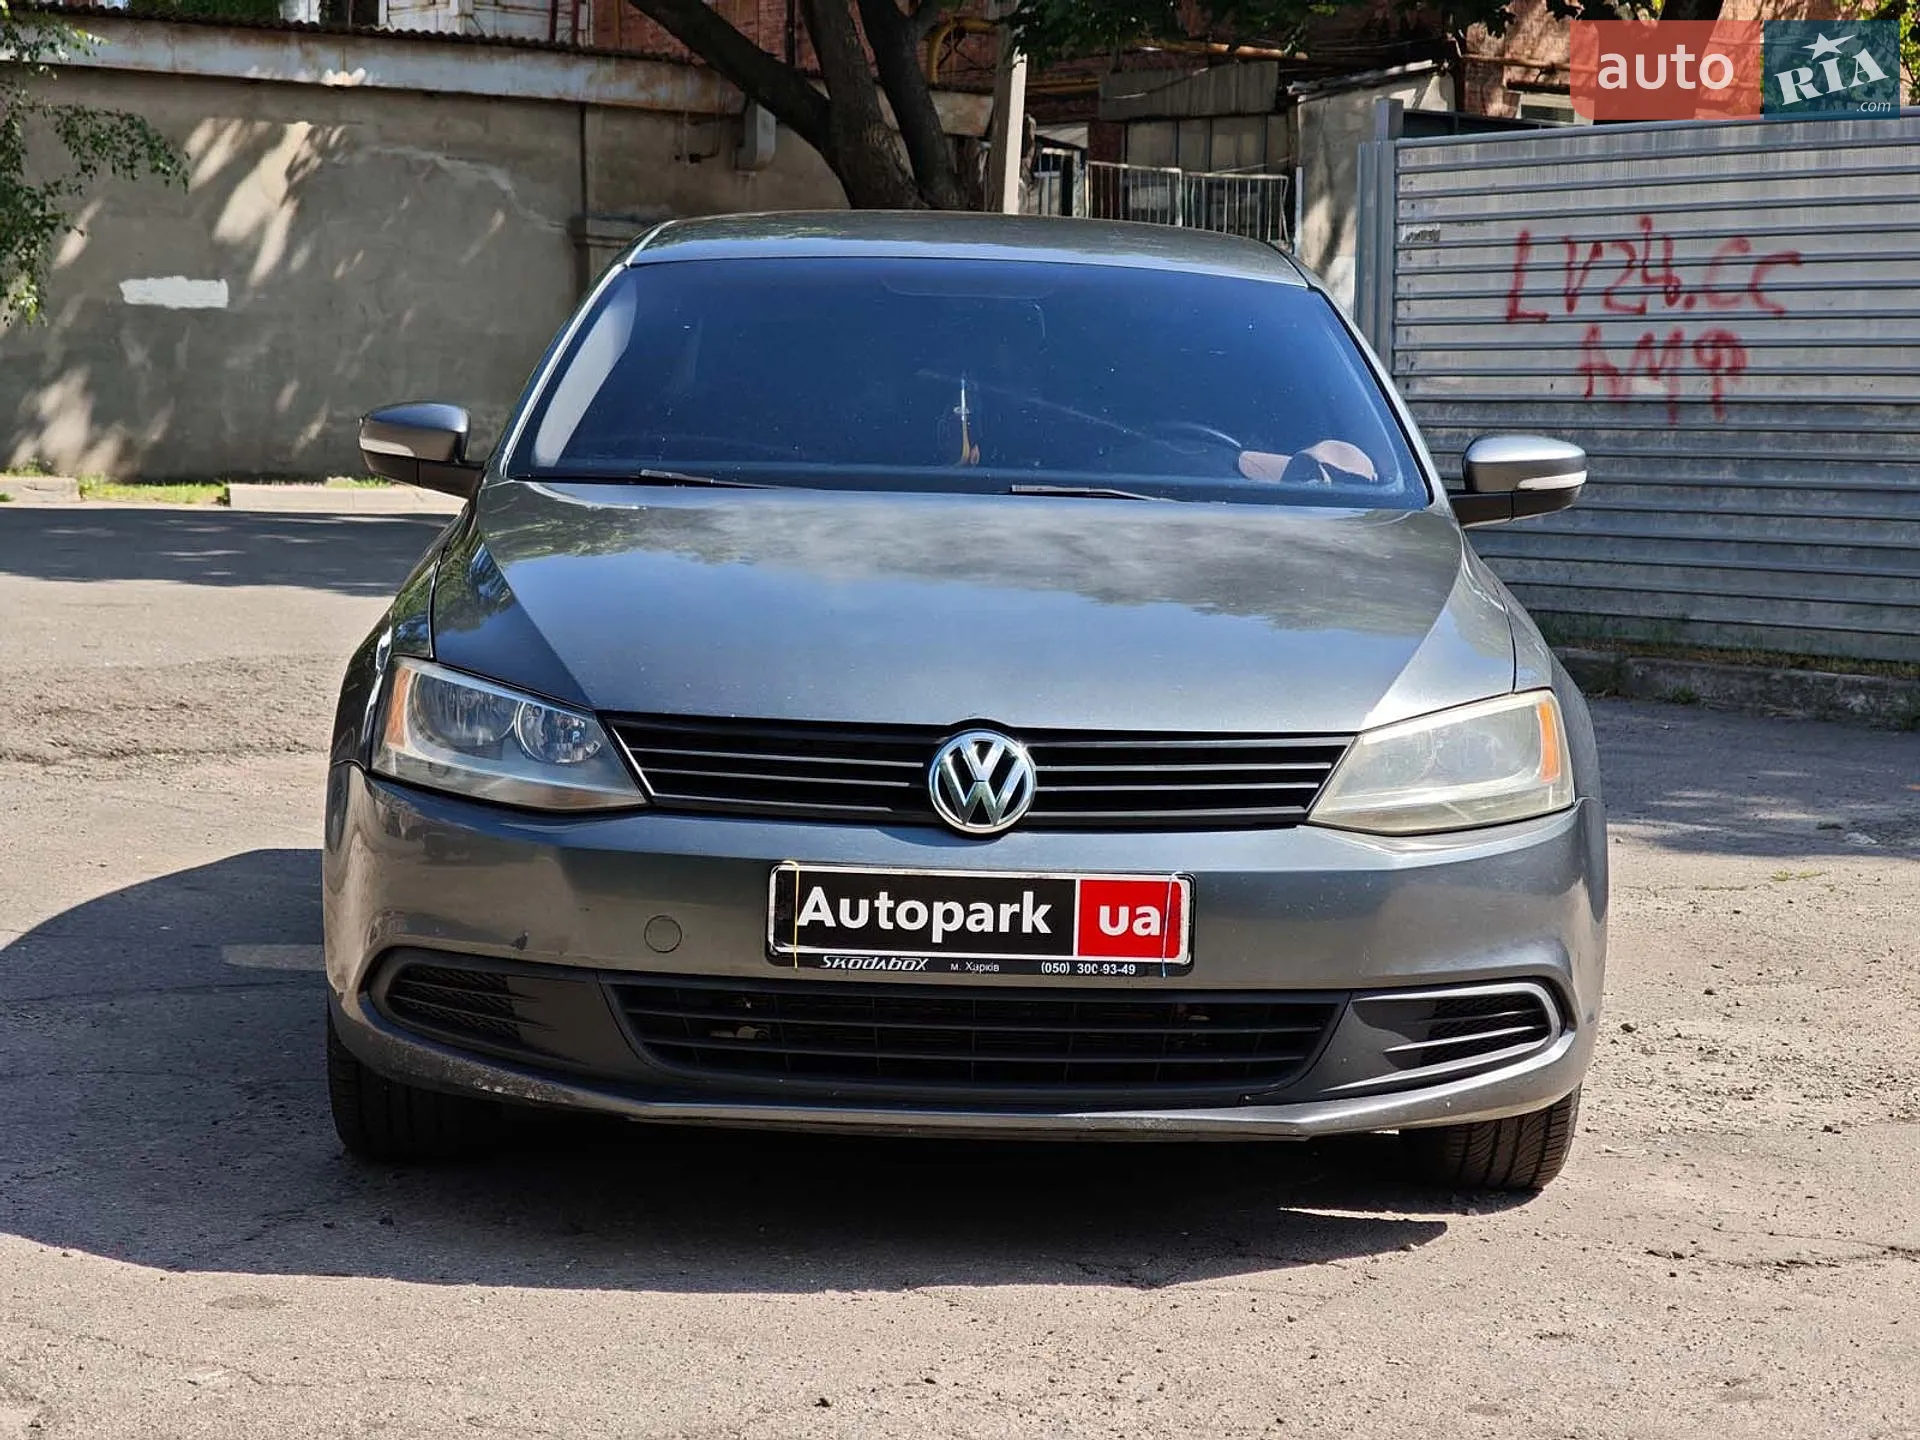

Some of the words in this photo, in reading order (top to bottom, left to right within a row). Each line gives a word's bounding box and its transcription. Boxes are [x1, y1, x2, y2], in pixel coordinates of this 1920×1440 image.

[797, 886, 1052, 944] Autopark
[1099, 904, 1162, 937] ua
[965, 961, 1000, 974] Харків
[1041, 962, 1070, 975] (050)
[1077, 963, 1136, 975] 300-93-49
